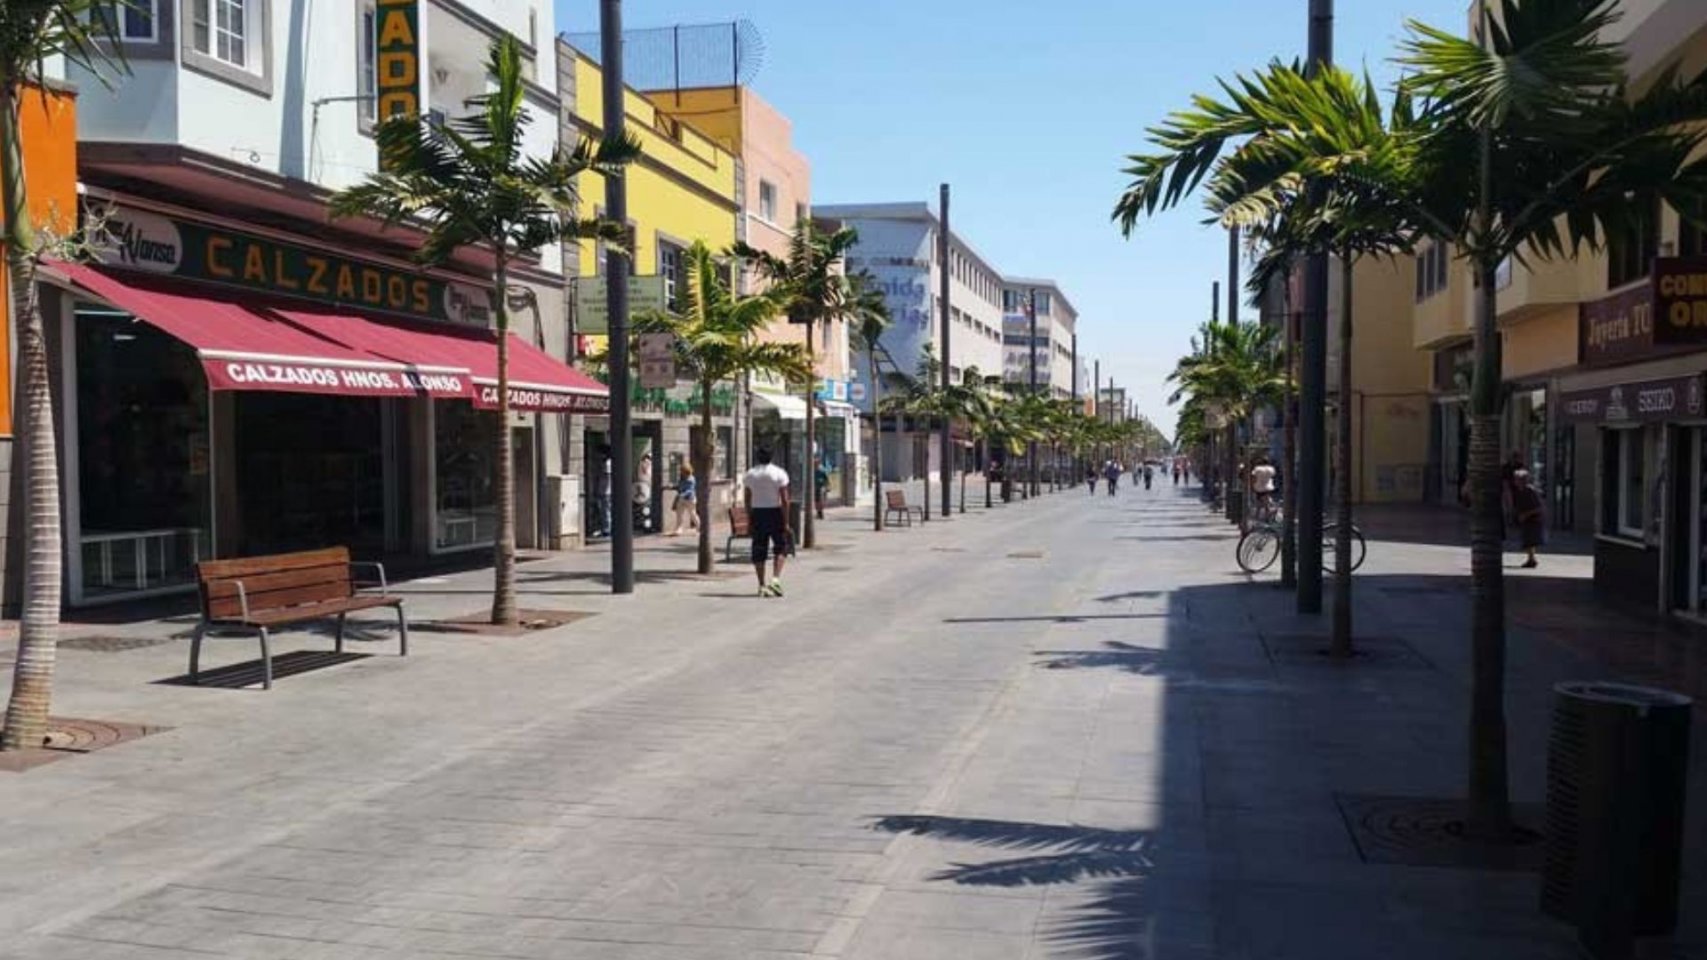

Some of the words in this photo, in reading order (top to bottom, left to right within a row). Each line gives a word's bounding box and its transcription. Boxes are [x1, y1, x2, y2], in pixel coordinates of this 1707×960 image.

[206, 234, 431, 313] CALZADOS
[227, 363, 338, 387] CALZADOS
[341, 370, 399, 389] HNOS.
[403, 375, 462, 392] ALONSO
[482, 387, 541, 406] CAZADOS
